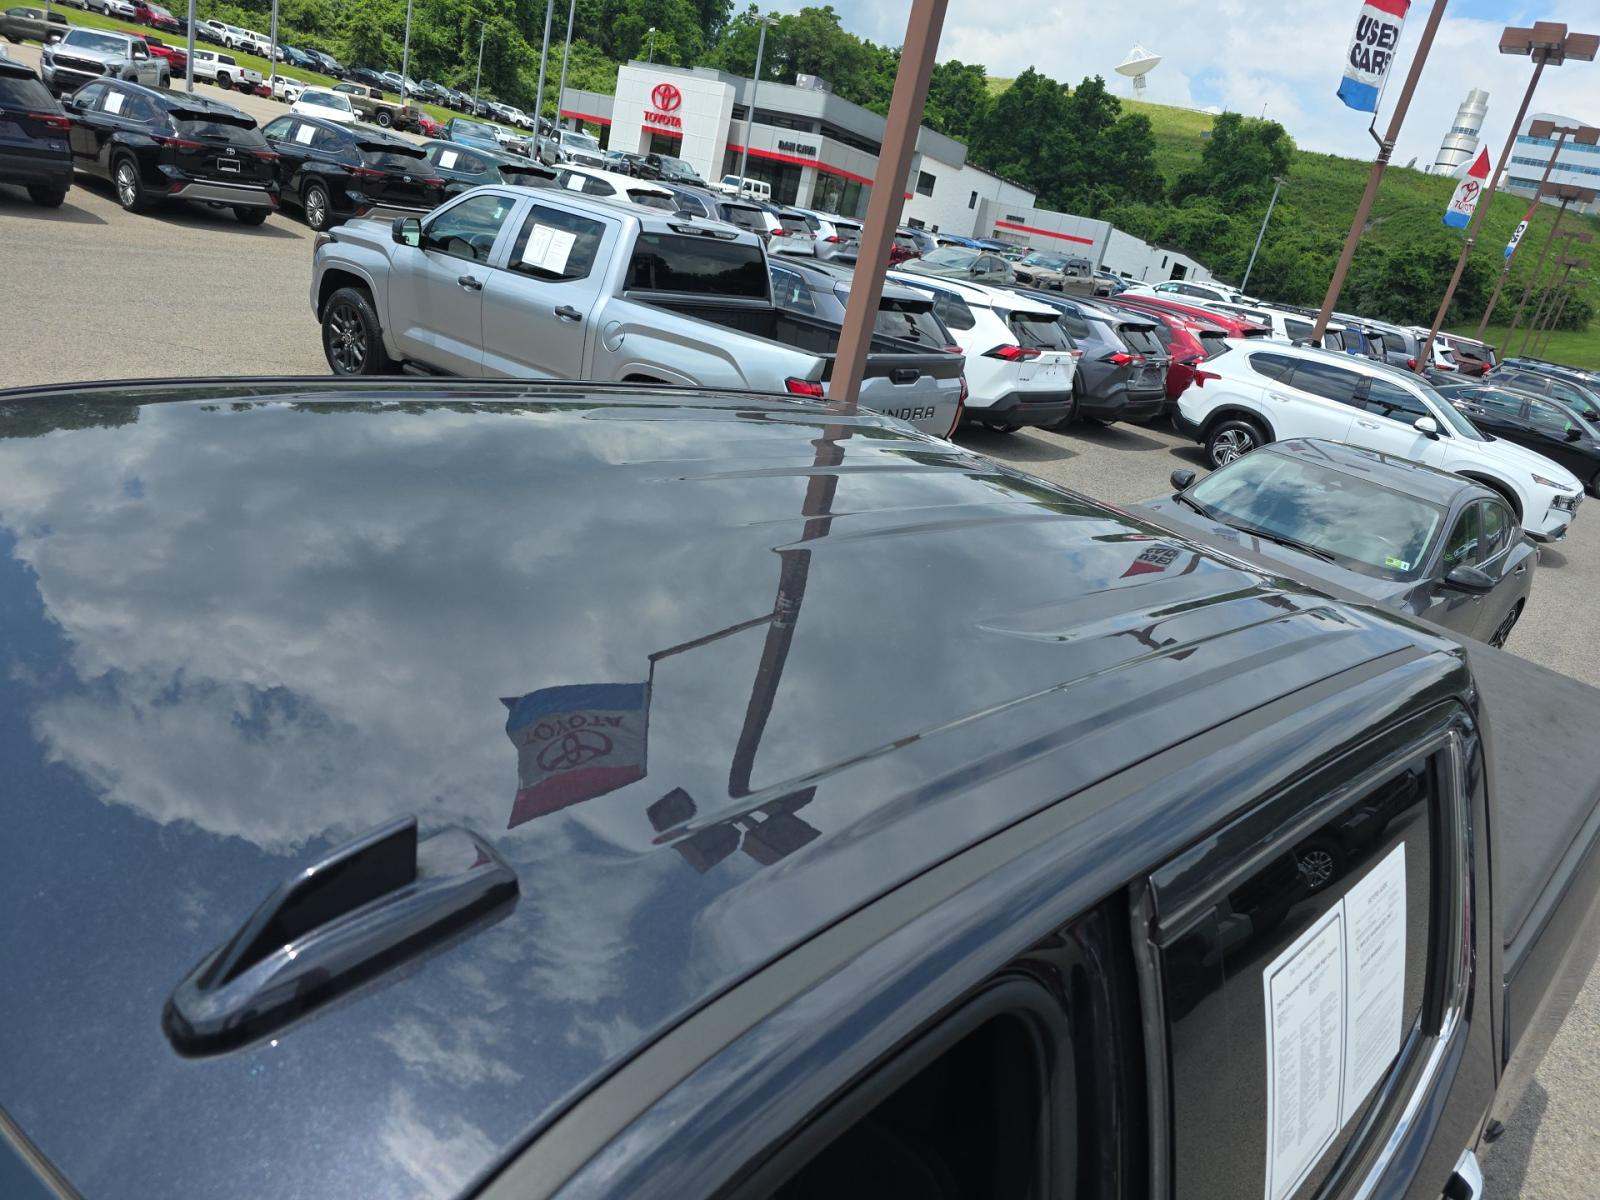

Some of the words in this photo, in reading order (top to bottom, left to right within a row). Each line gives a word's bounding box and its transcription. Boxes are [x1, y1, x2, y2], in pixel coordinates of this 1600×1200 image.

[1356, 14, 1399, 51] USED
[643, 110, 682, 128] TOYOTA
[881, 406, 935, 421] NDRA
